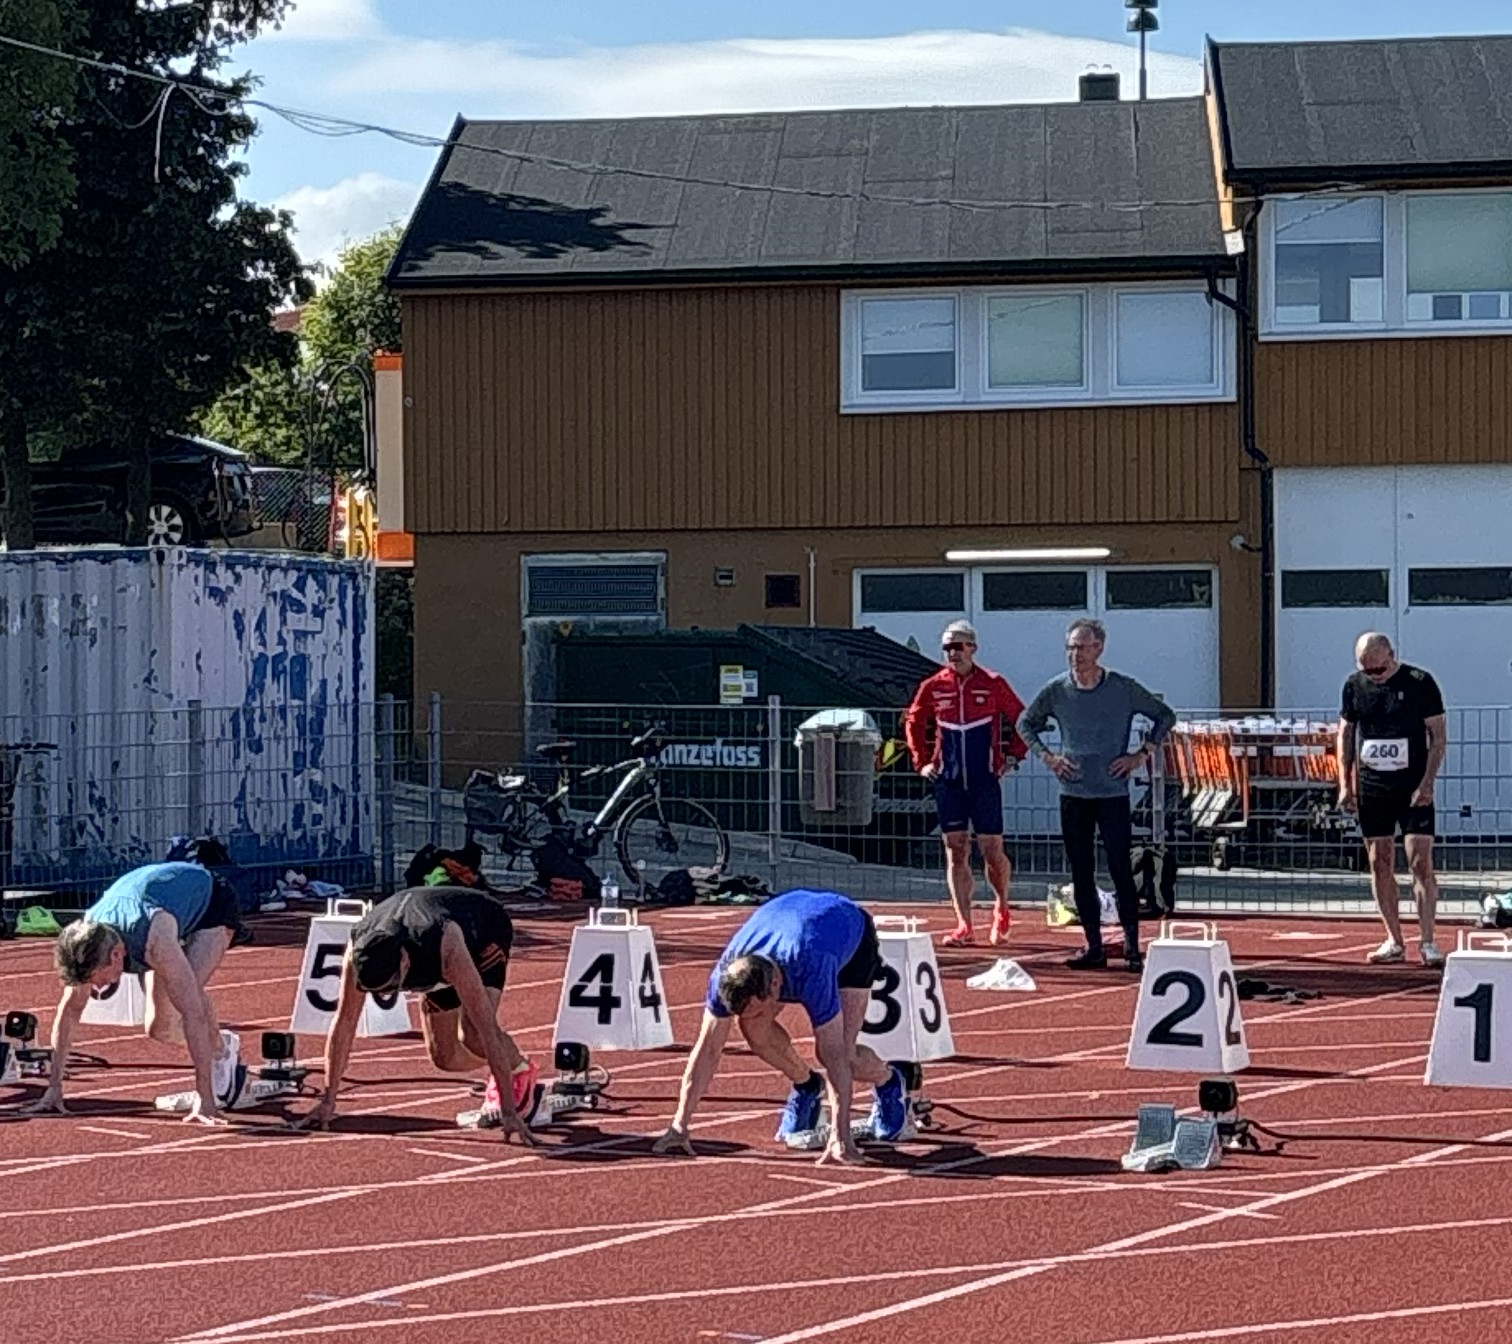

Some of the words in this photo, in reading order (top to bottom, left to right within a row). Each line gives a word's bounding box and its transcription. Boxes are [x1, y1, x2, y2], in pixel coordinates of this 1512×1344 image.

[1369, 743, 1399, 758] 260
[306, 943, 347, 1011] 5
[569, 953, 621, 1025] 4
[639, 952, 662, 1023] 4
[861, 964, 901, 1034] 3
[916, 961, 941, 1033] 3
[1146, 970, 1205, 1048] 2
[1219, 970, 1241, 1046] 2
[1454, 983, 1494, 1063] 1
